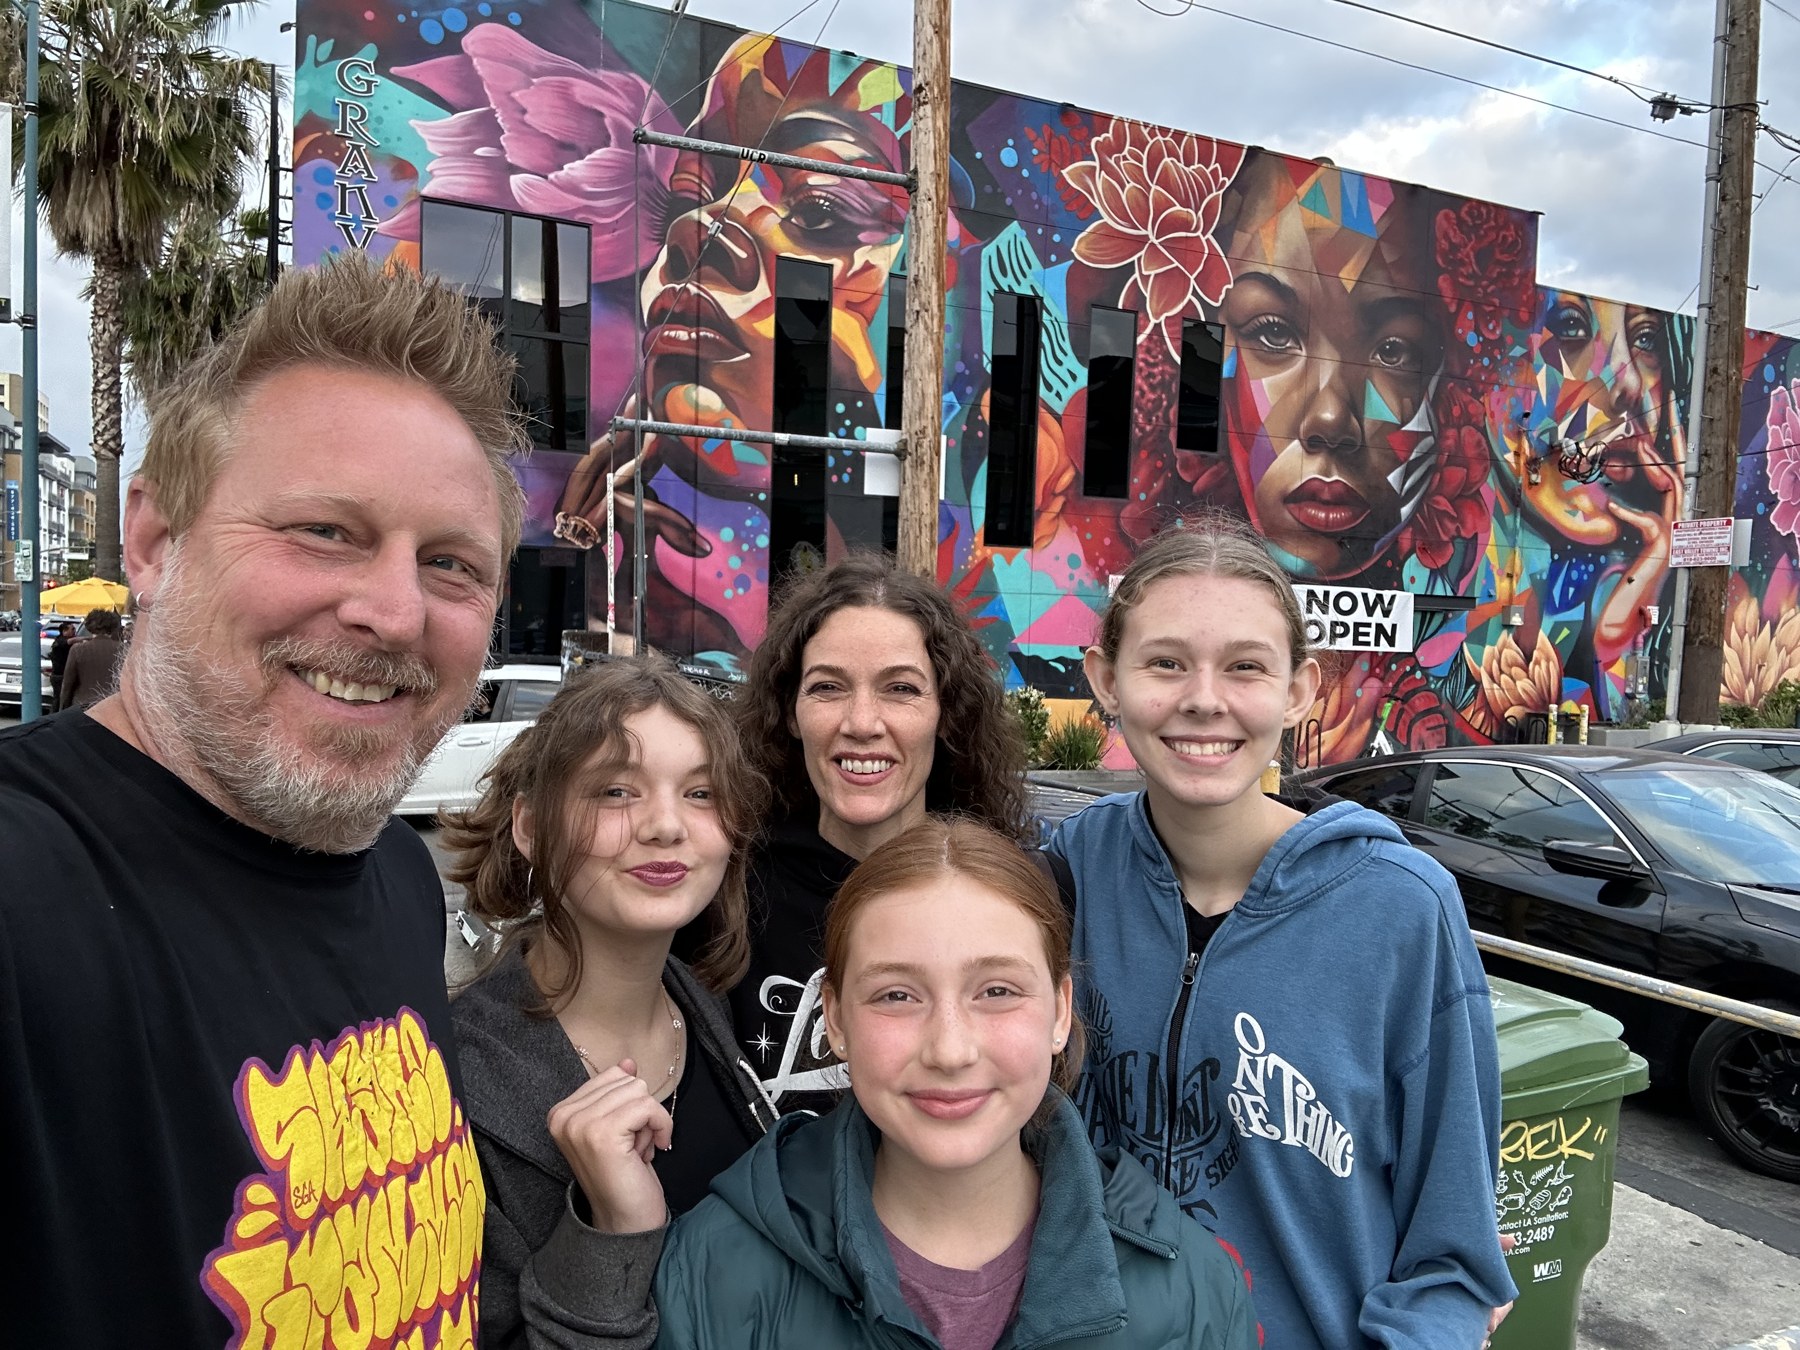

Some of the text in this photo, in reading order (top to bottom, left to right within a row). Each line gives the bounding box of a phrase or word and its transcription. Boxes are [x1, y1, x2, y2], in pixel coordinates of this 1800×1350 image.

[1699, 519, 1727, 527] PROPERTY
[1305, 589, 1397, 618] NOW
[1303, 619, 1397, 648] OPEN
[1267, 1053, 1354, 1178] THING
[1497, 1210, 1569, 1231] ontact LA Sanitation:
[1509, 1225, 1555, 1246] 3-2489
[1533, 1259, 1562, 1278] WM
